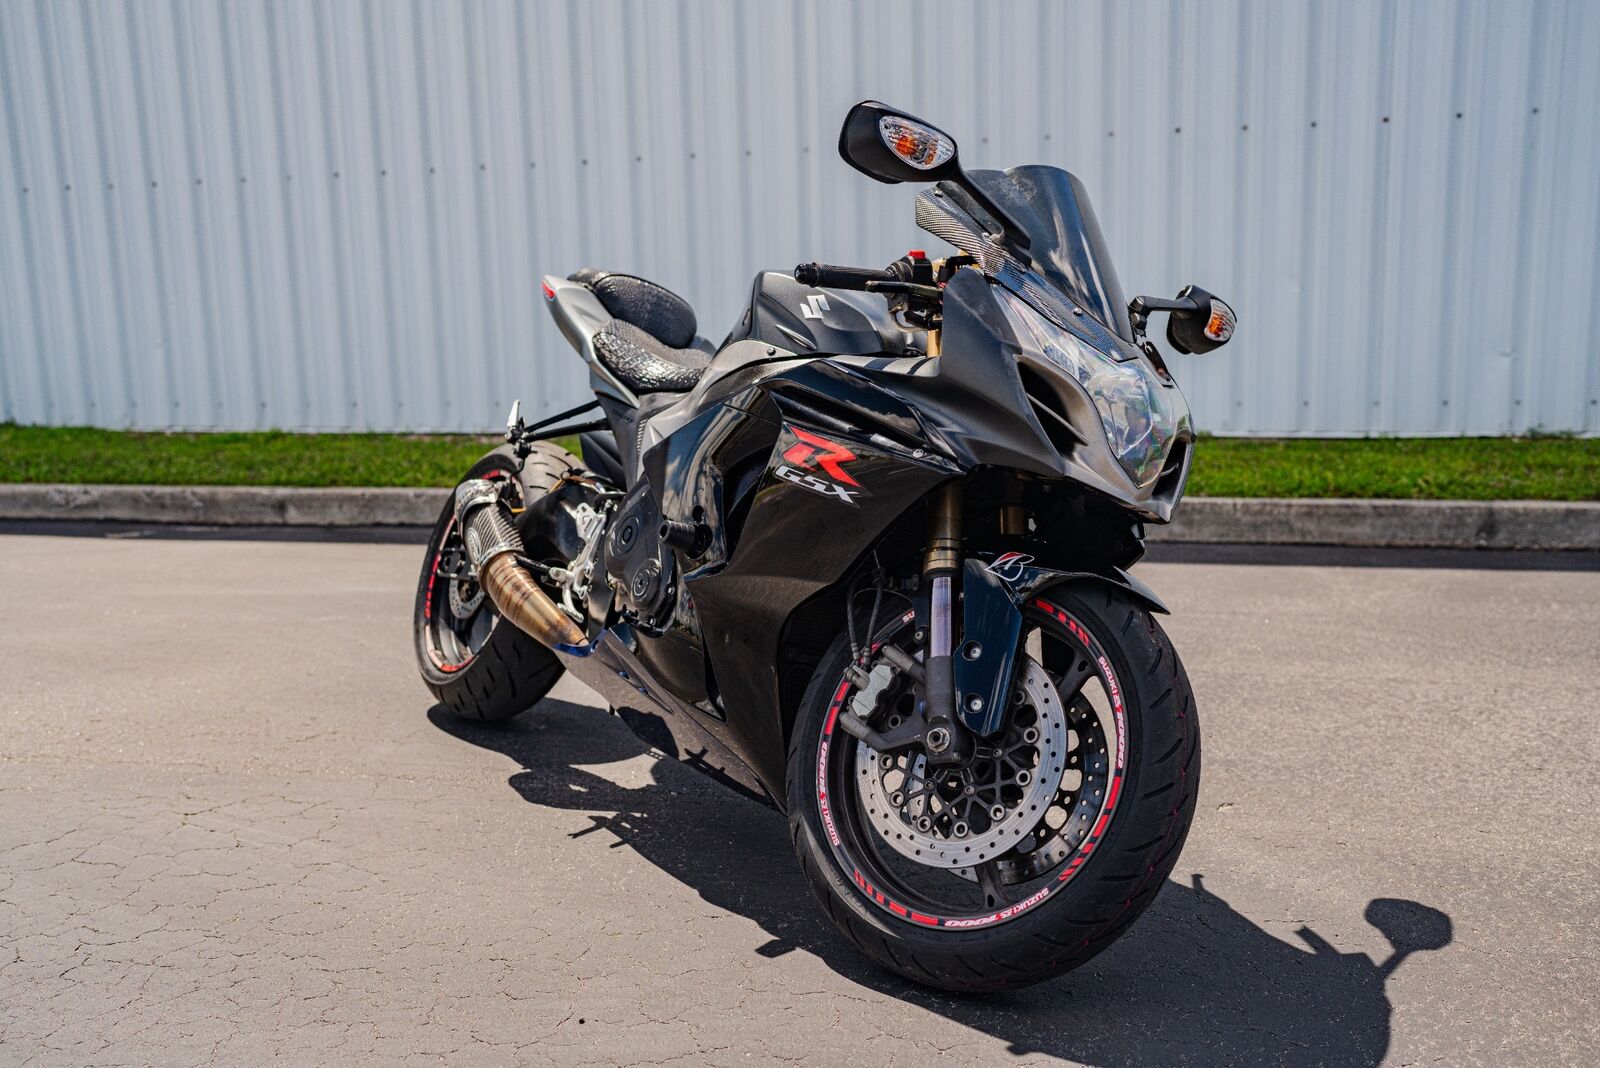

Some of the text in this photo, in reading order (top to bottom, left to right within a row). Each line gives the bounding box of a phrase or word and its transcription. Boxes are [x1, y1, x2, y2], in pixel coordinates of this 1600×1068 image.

[782, 424, 862, 488] R
[775, 465, 859, 504] GSX
[1099, 656, 1119, 694] SUZUKI
[822, 810, 840, 846] SUZUKI
[1013, 887, 1050, 914] SUZUKI
